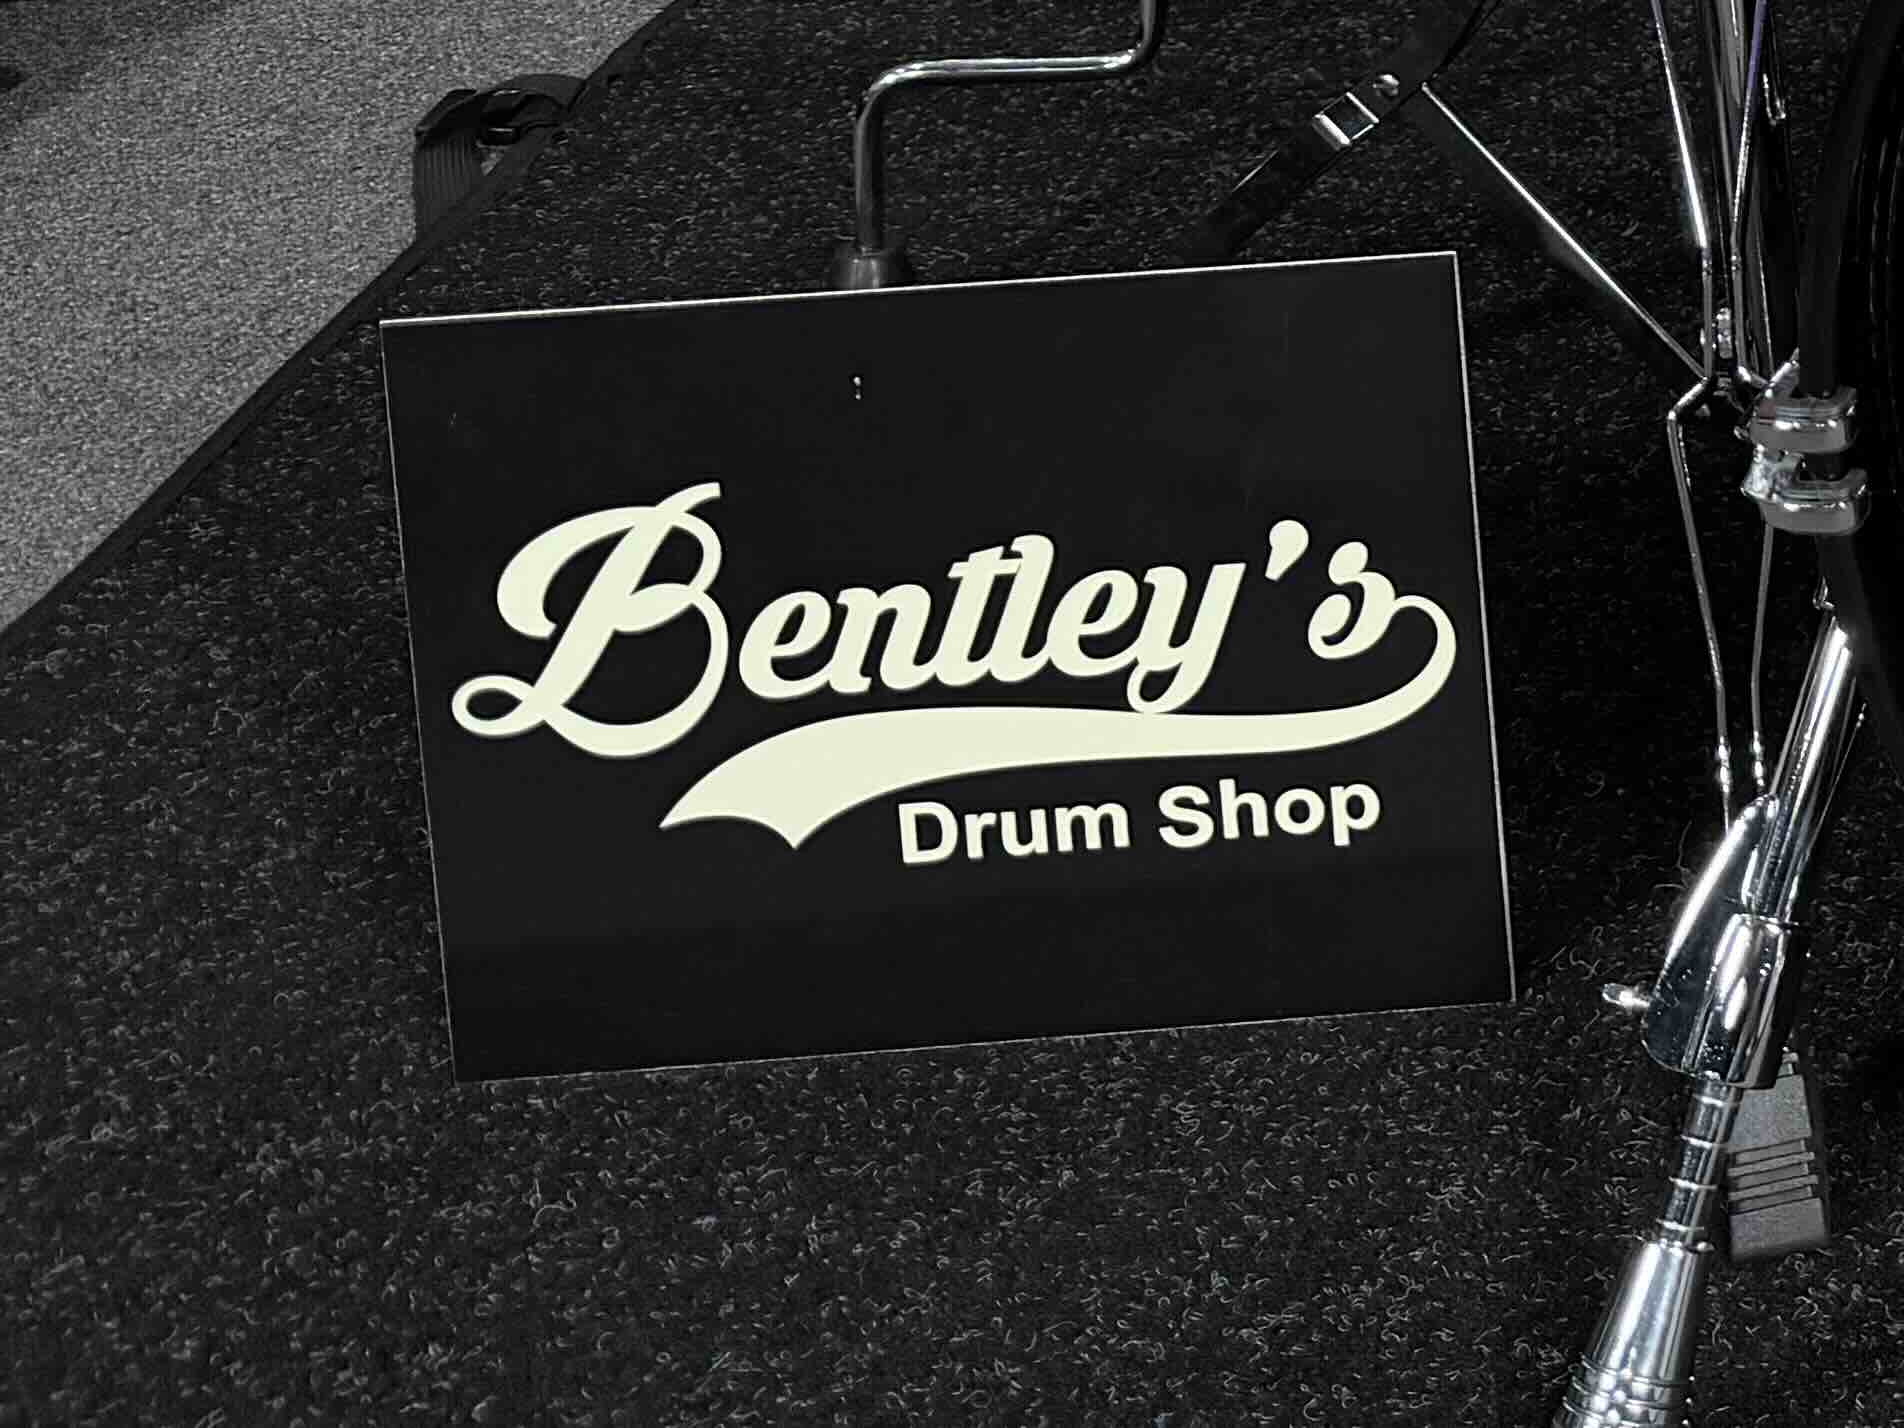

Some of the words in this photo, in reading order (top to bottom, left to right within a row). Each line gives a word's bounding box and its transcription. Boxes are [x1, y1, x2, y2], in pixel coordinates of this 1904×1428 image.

[450, 481, 1456, 758] Bentley's
[897, 794, 1132, 867] Drum
[1158, 775, 1382, 850] Shop
